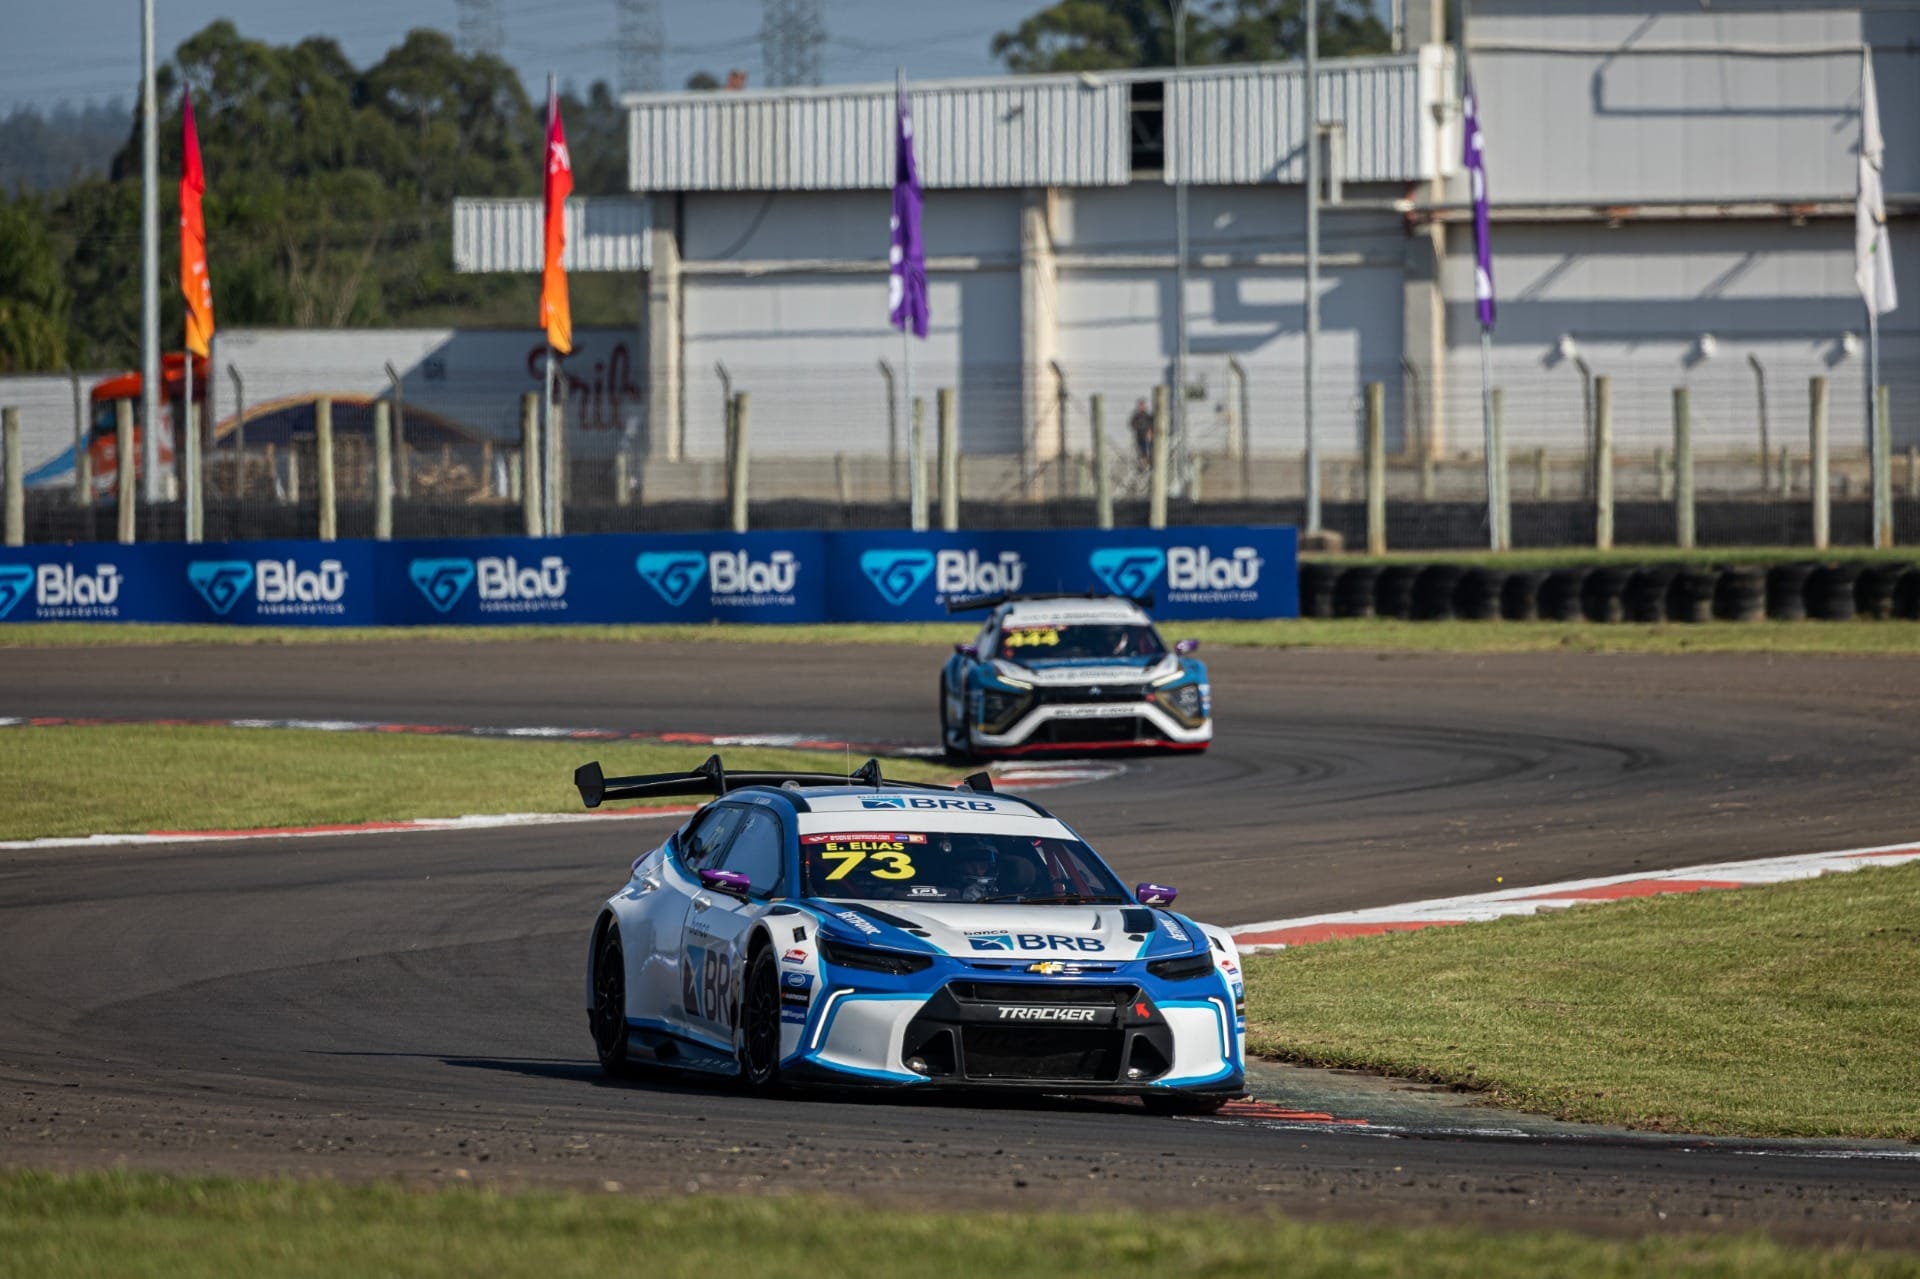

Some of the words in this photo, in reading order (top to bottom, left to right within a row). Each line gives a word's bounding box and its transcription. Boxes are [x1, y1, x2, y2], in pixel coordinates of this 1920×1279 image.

[909, 798, 996, 812] BRB
[826, 843, 844, 851] E.
[850, 842, 904, 851] ELIAS
[821, 851, 916, 880] 73
[1017, 934, 1105, 952] BRB
[704, 949, 731, 1027] BR
[997, 1006, 1096, 1022] TRACKER
